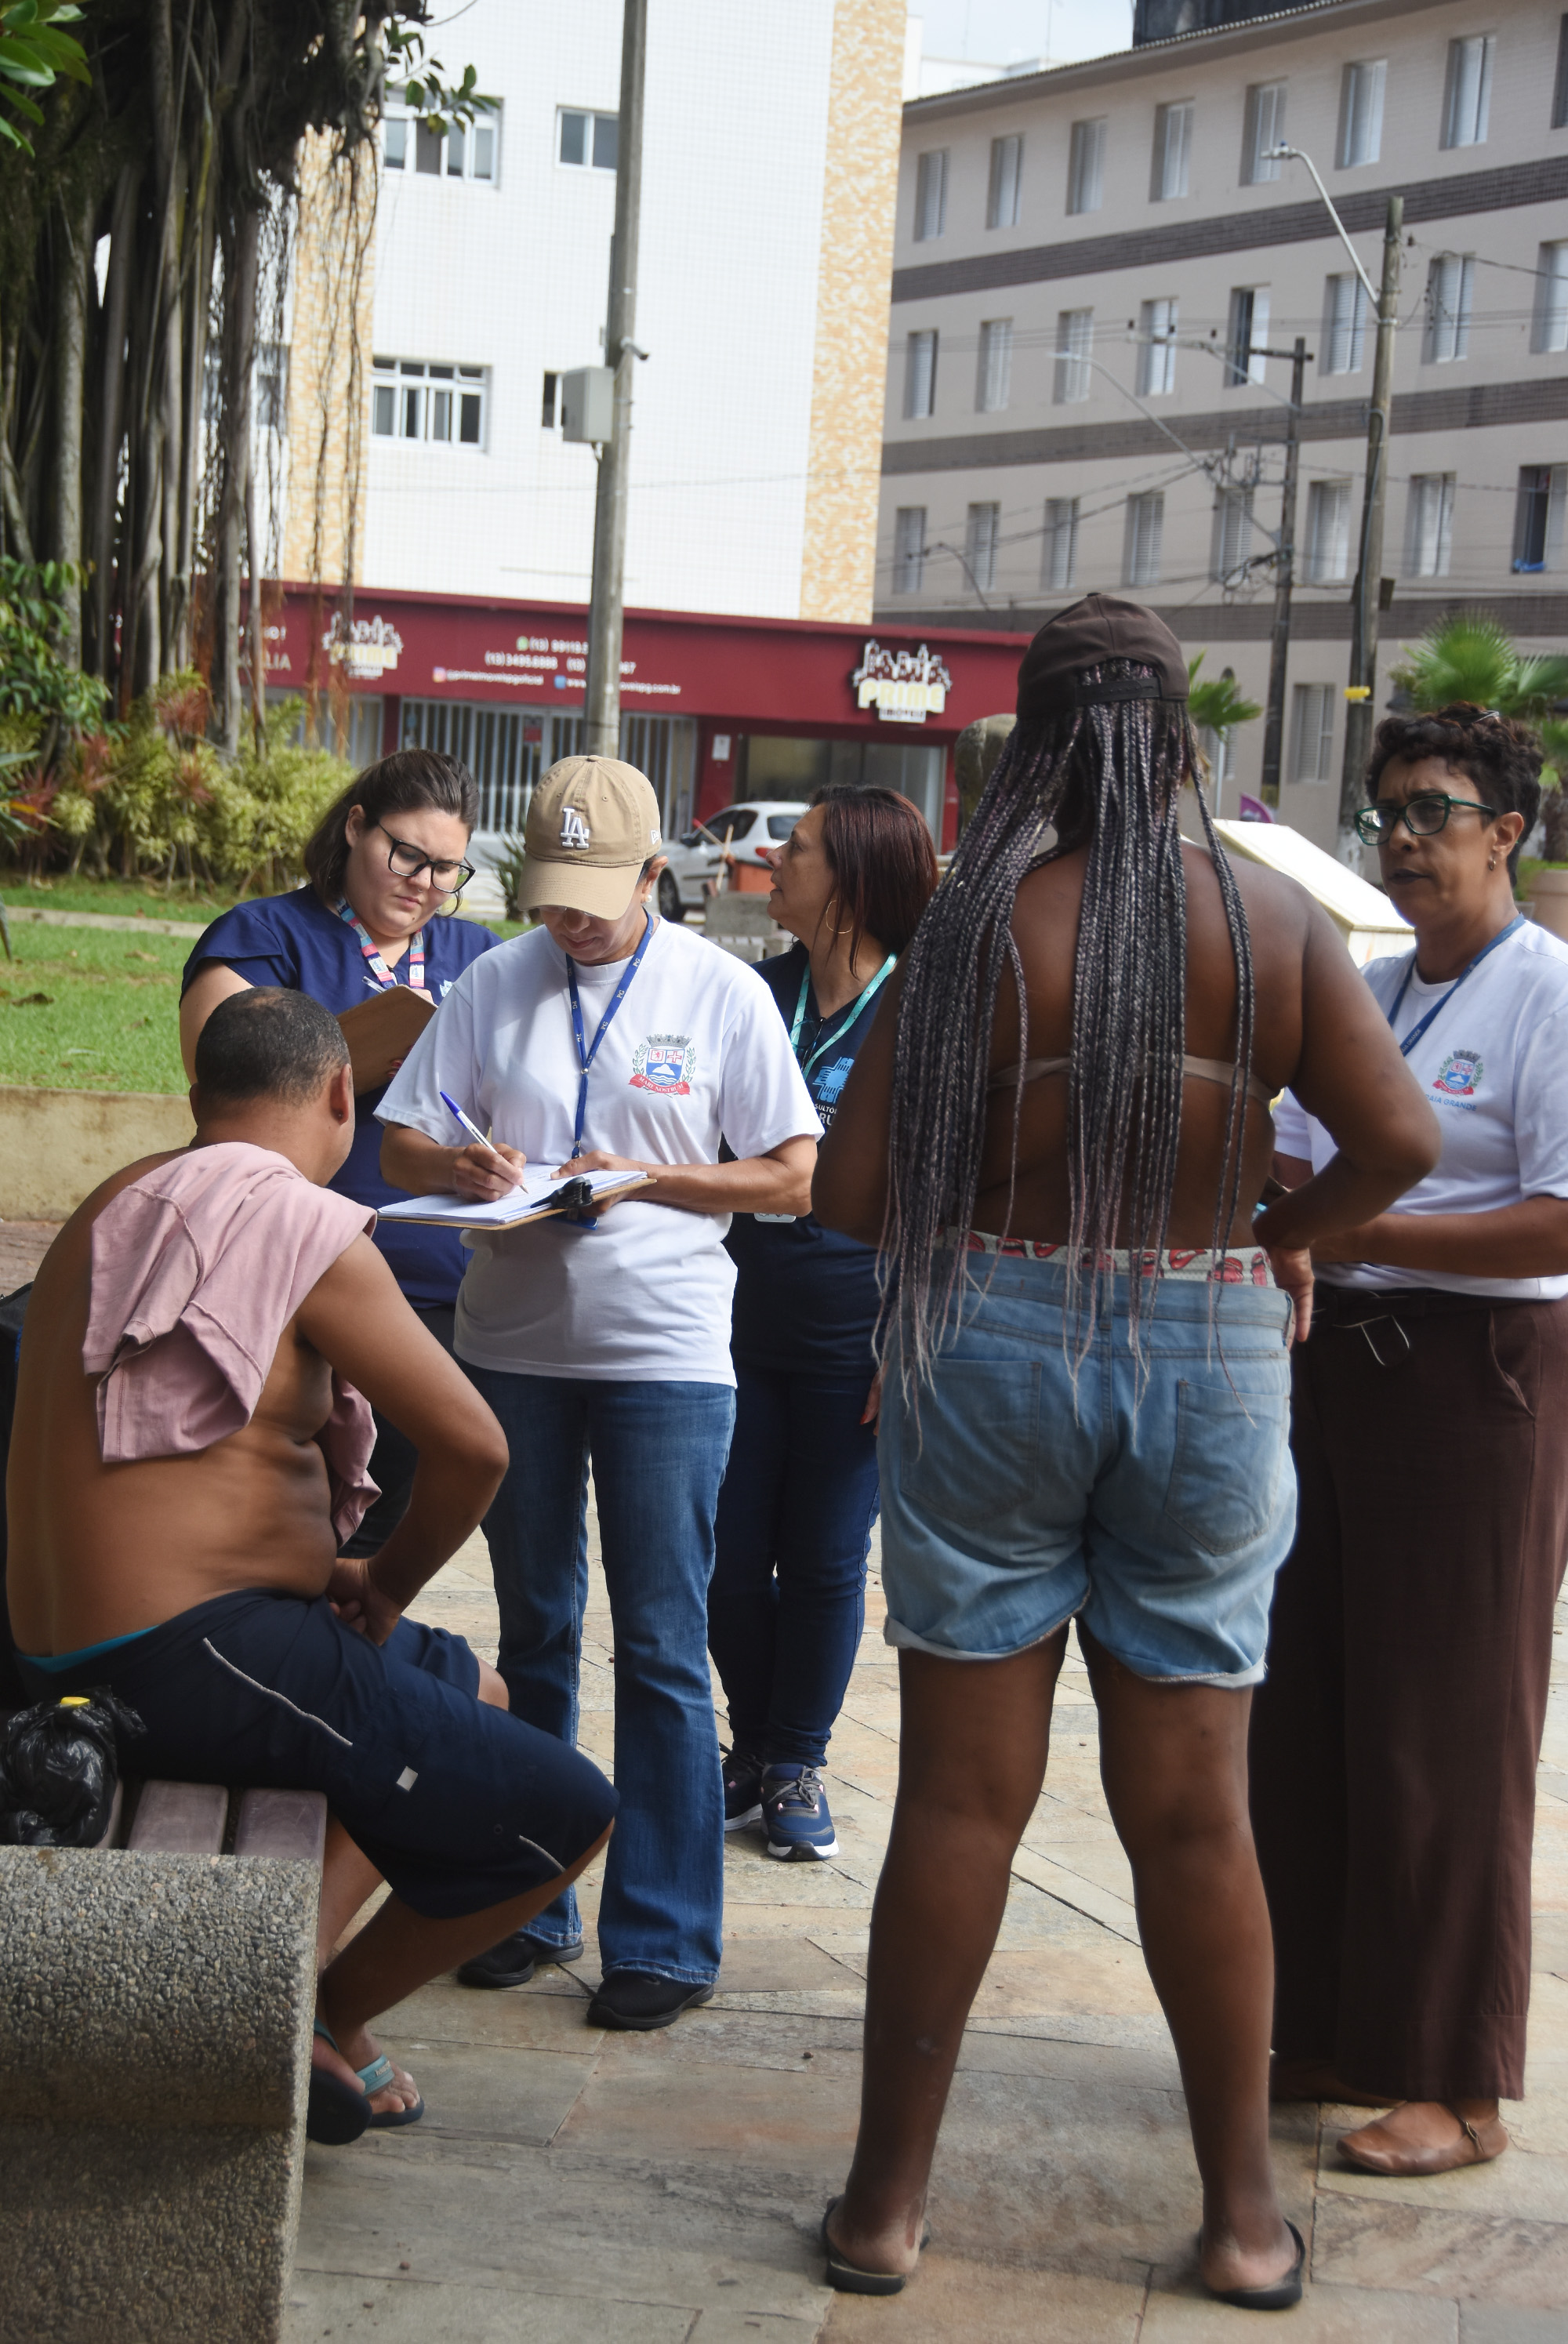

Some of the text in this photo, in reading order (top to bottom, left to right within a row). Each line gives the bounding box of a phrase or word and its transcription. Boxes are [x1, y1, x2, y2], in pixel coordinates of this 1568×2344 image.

[860, 679, 945, 711] PRIME
[561, 808, 590, 849] LA
[633, 957, 641, 967] PG
[616, 989, 625, 999] PG
[601, 1021, 608, 1030] PG
[638, 1076, 684, 1093] MARE NOSTRUM
[1443, 1099, 1477, 1112] GRANDE
